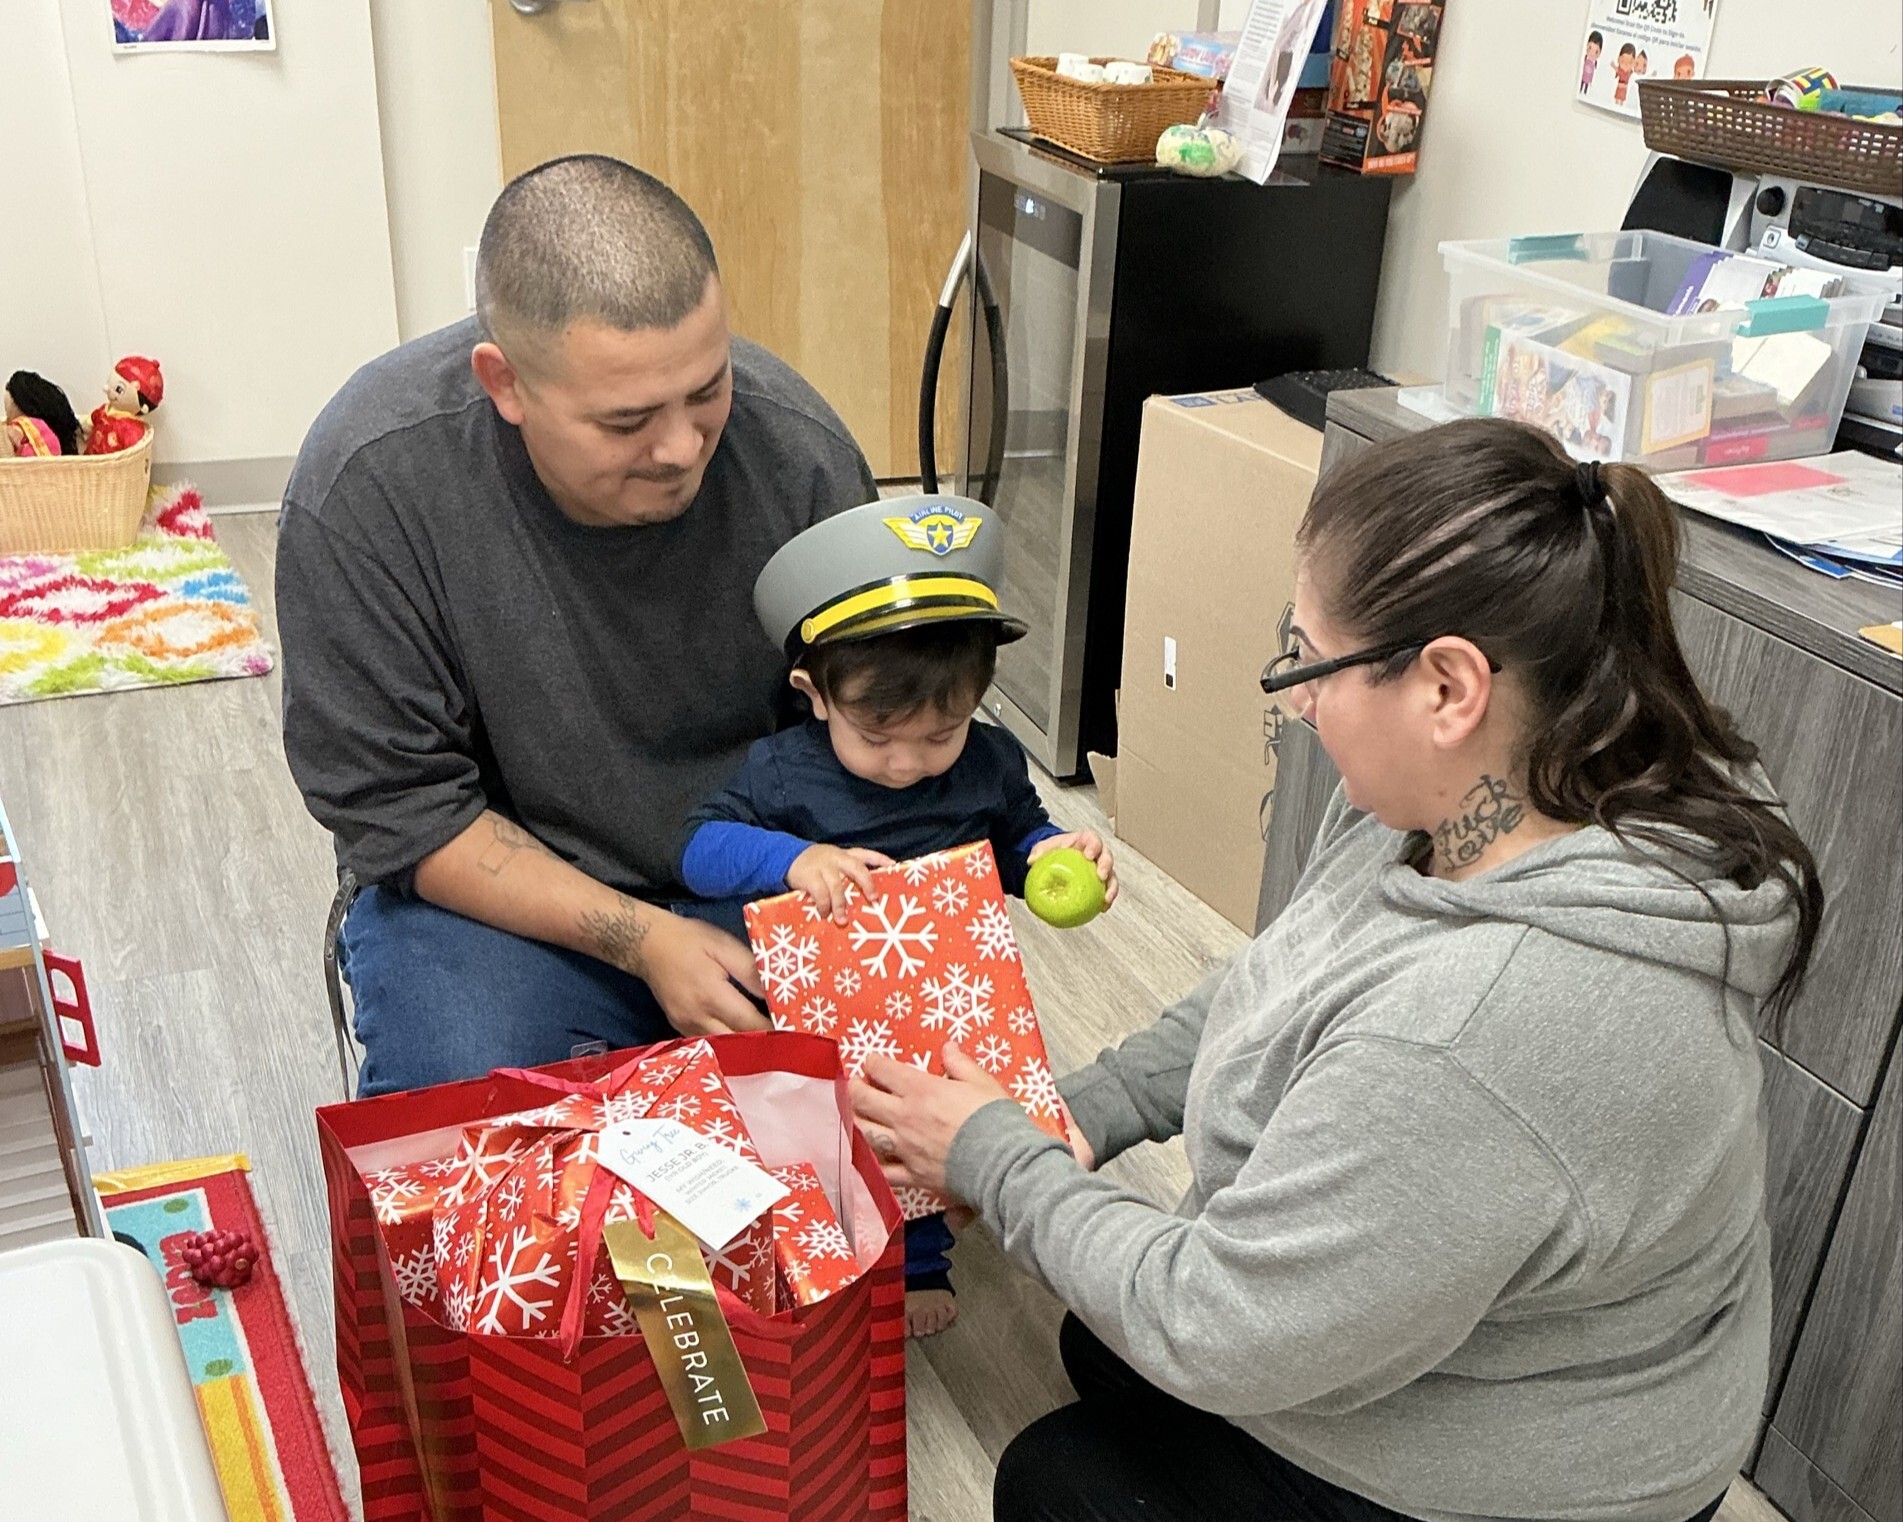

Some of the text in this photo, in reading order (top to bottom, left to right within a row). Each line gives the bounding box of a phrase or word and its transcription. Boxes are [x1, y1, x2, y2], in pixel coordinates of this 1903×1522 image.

[914, 506, 963, 520] AIRLINE PILOT
[620, 1125, 680, 1165] Giving Tree
[646, 1157, 679, 1183] JESSE
[679, 1148, 695, 1160] JR.
[646, 1253, 730, 1425] CELEBRATE
